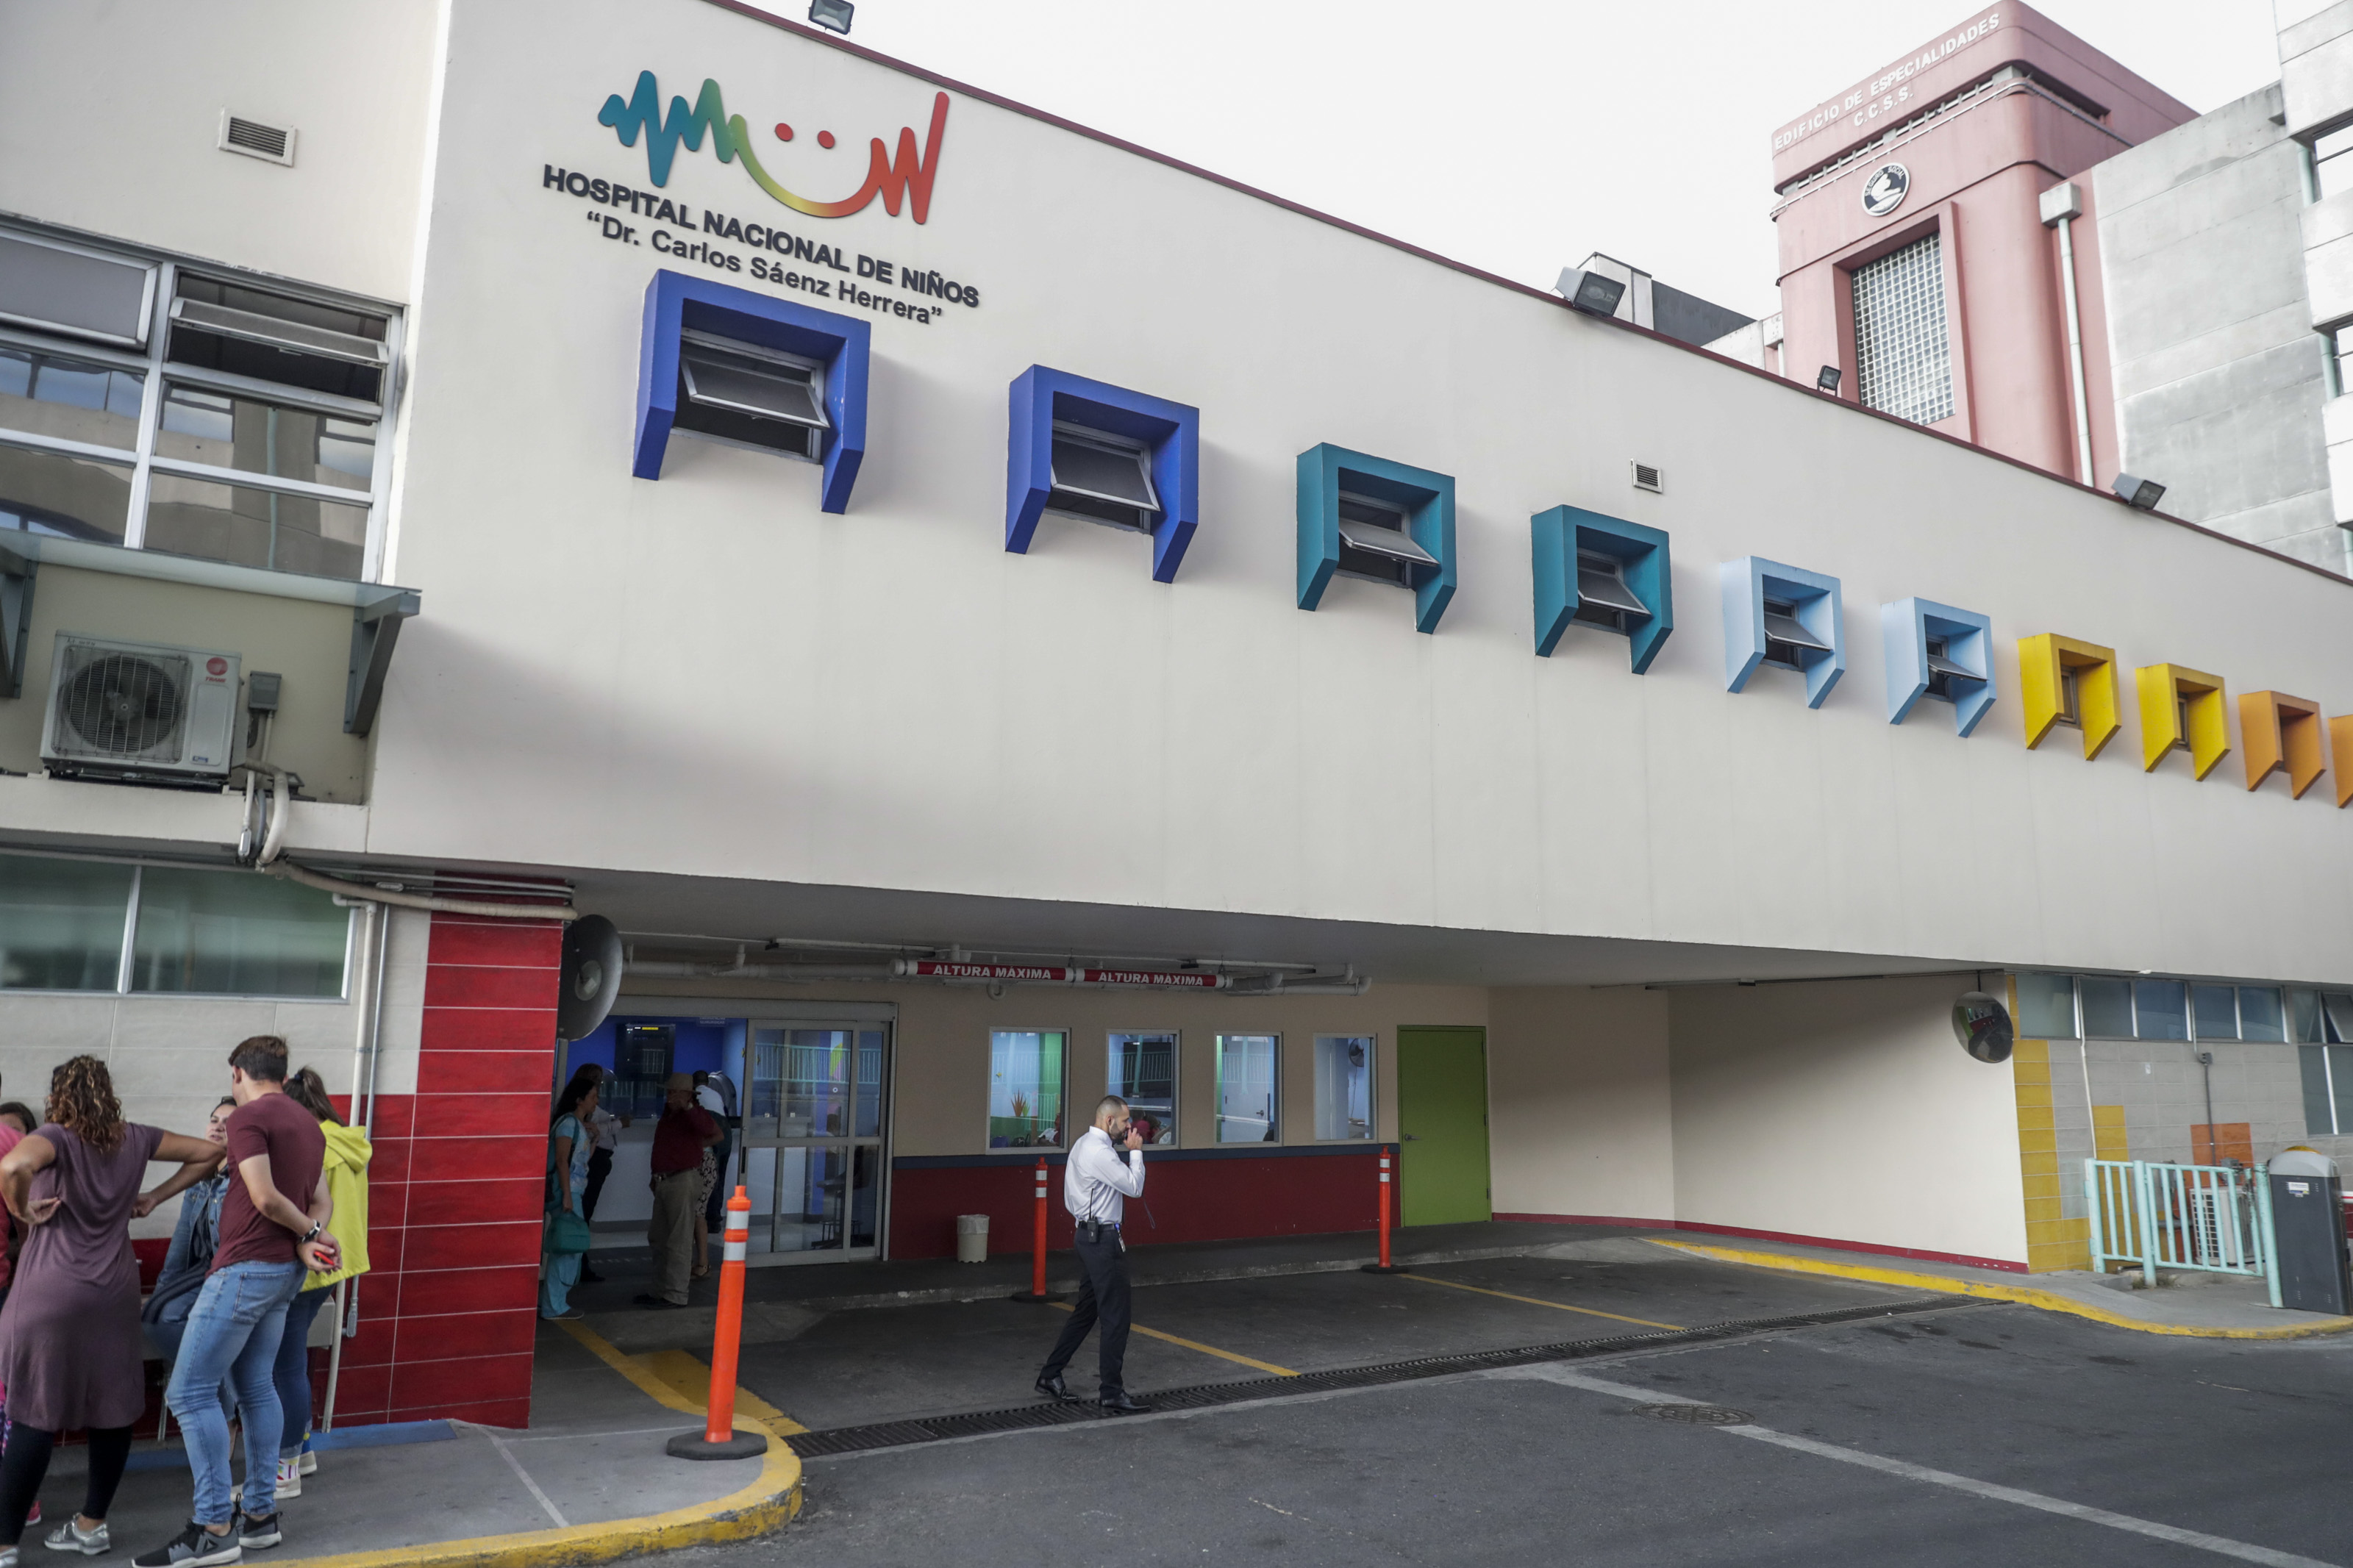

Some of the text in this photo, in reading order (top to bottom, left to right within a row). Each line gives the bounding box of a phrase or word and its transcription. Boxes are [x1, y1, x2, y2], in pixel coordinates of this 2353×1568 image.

[1774, 12, 2000, 151] EDIFICIO DE ESPECIALIDADES
[1865, 165, 1904, 196] SEGURO SOCIAL
[543, 163, 979, 308] HOSPITAL NACIONAL DE NIÑOS
[651, 229, 741, 272] Carlos
[750, 257, 830, 298] Sáenz
[932, 964, 993, 978] ALTURA
[1098, 971, 1150, 984] ALTURA
